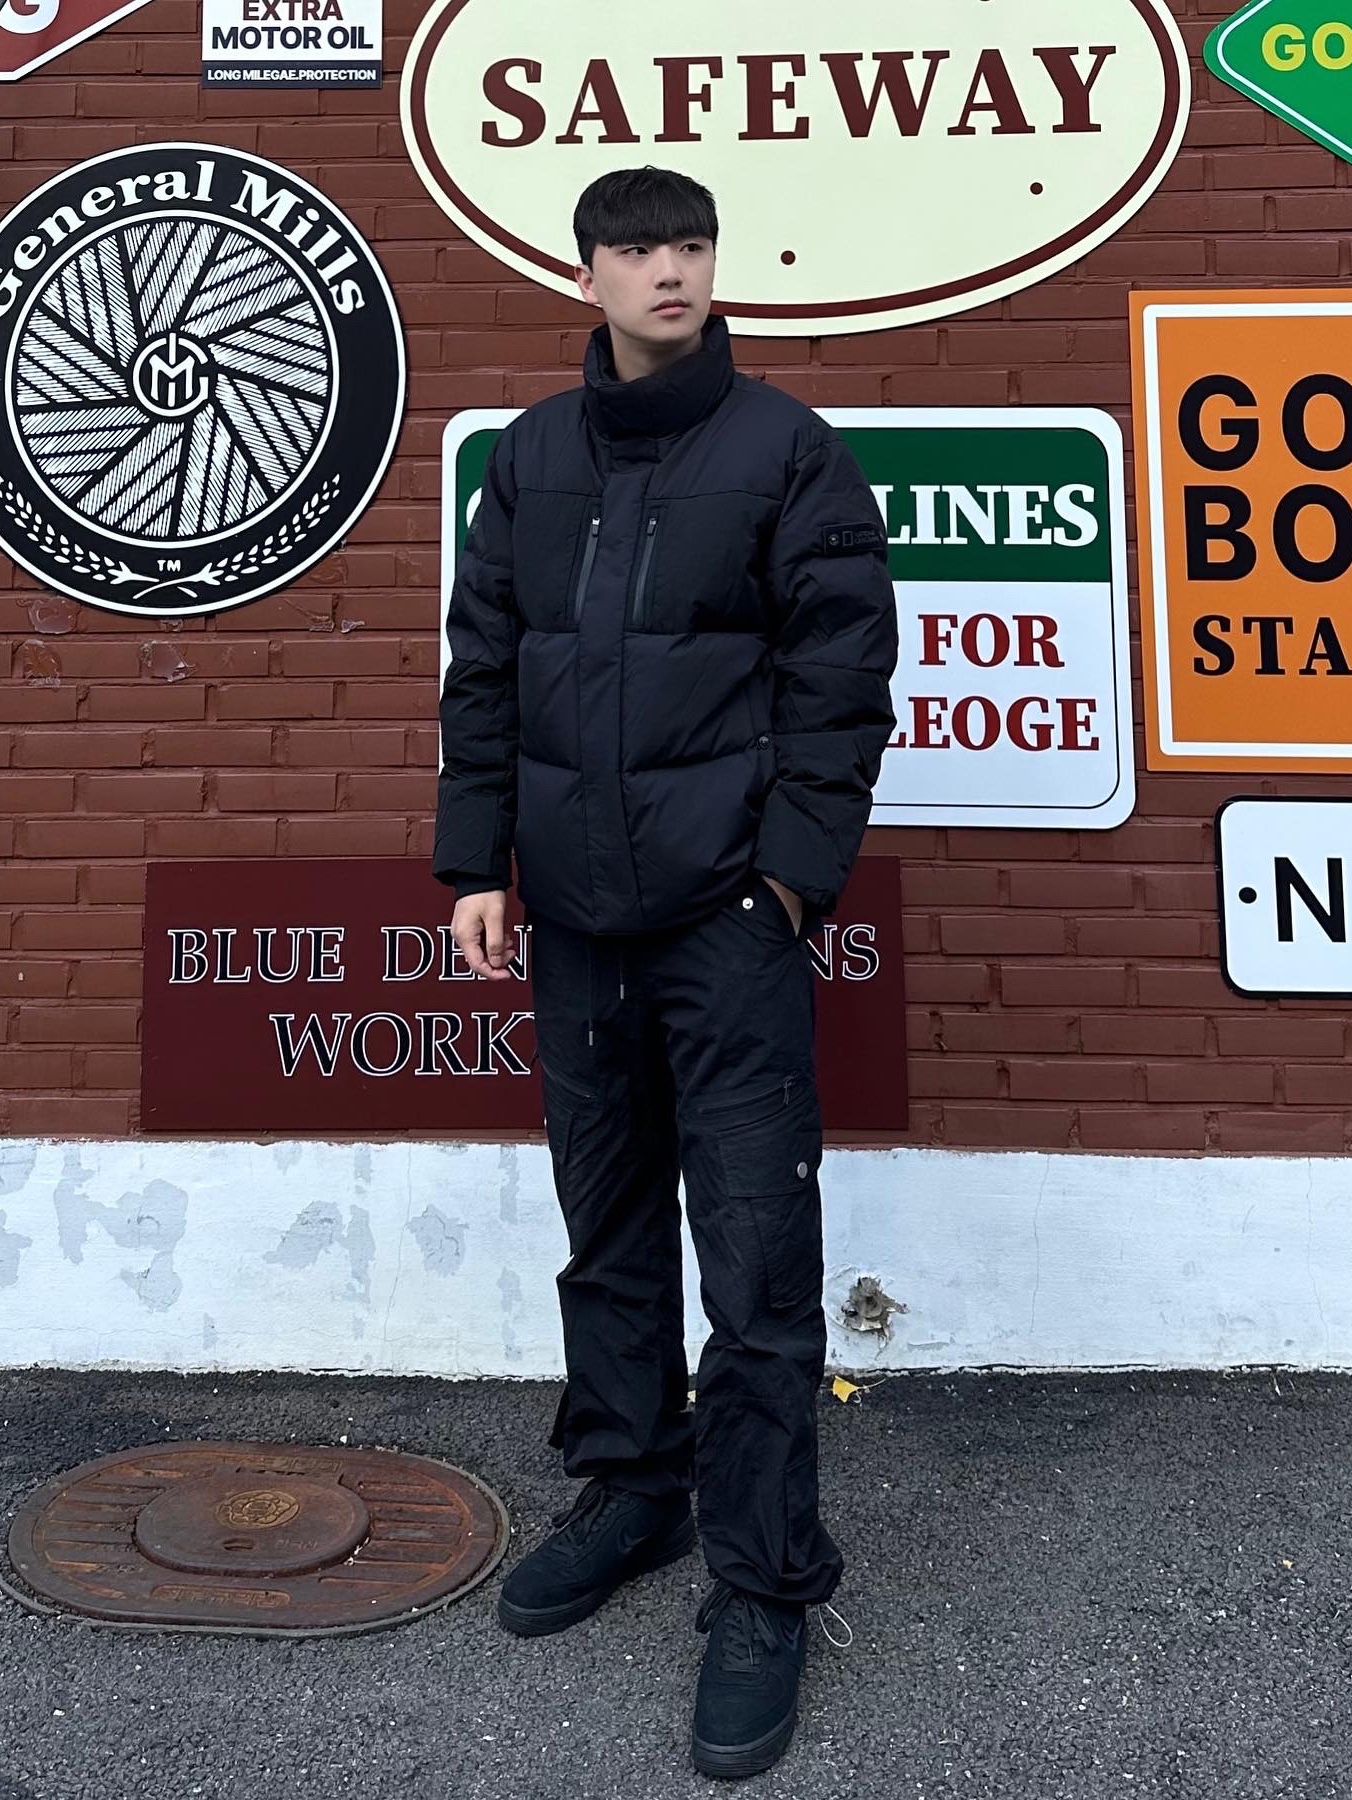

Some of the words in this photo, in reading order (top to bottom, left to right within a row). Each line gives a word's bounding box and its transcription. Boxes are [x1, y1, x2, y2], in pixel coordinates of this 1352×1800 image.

[212, 26, 322, 50] MOTOR
[327, 26, 373, 49] OIL
[243, 0, 343, 21] EXTRA
[207, 69, 241, 81] LONG
[1261, 22, 1352, 72] GO
[481, 45, 1117, 148] SAFEWAY
[230, 169, 366, 315] Mills
[1178, 373, 1352, 472] GO
[1183, 483, 1352, 583] BO
[156, 559, 181, 572] TM
[918, 613, 1065, 668] FOR
[1192, 614, 1352, 677] STA
[167, 927, 345, 984] BLUE
